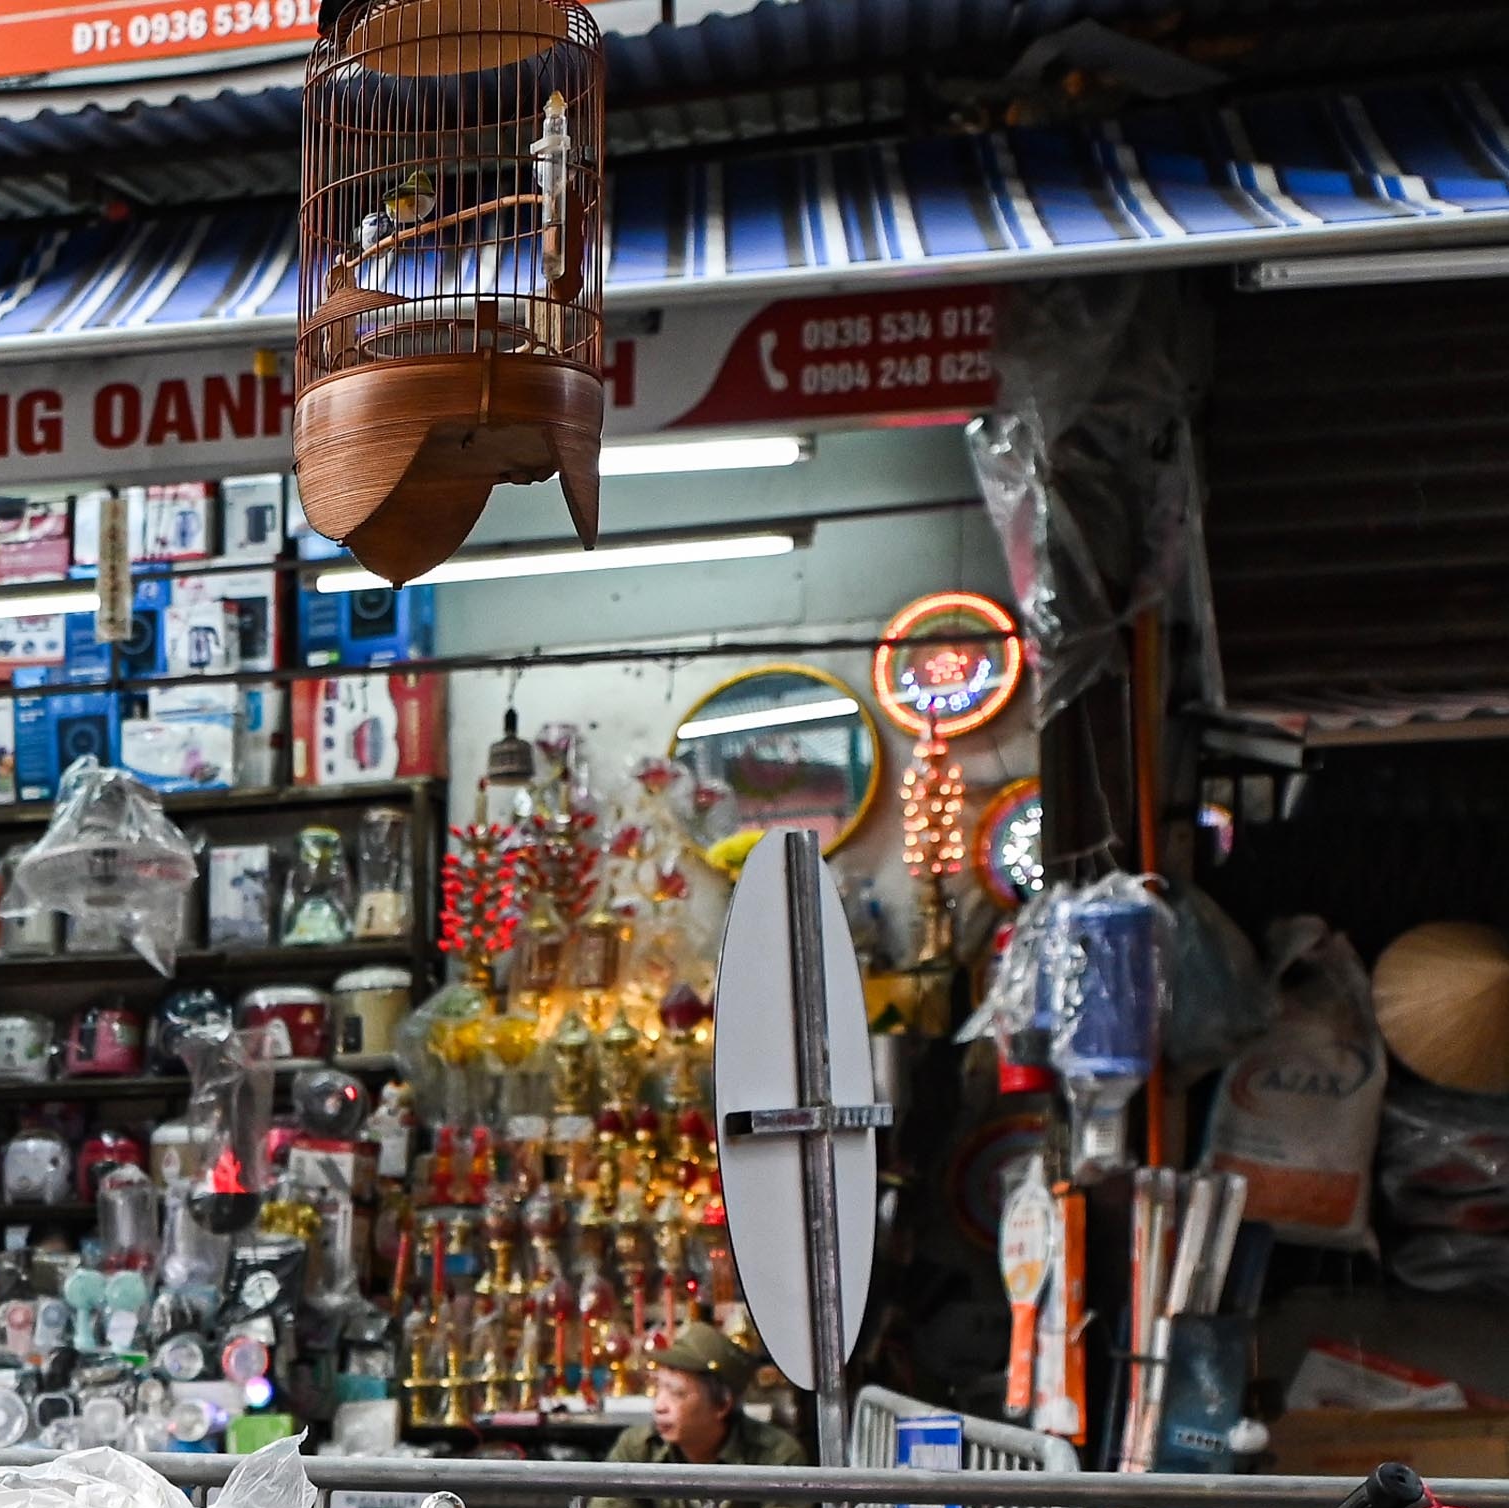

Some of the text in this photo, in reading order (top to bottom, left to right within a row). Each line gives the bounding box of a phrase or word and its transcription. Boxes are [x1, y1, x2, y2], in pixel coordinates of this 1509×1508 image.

[71, 20, 120, 54] ĐT:
[128, 7, 207, 47] 0936
[213, 0, 272, 37] 534
[802, 305, 994, 351] 0936 534 912
[800, 349, 993, 396] 0904 248 625
